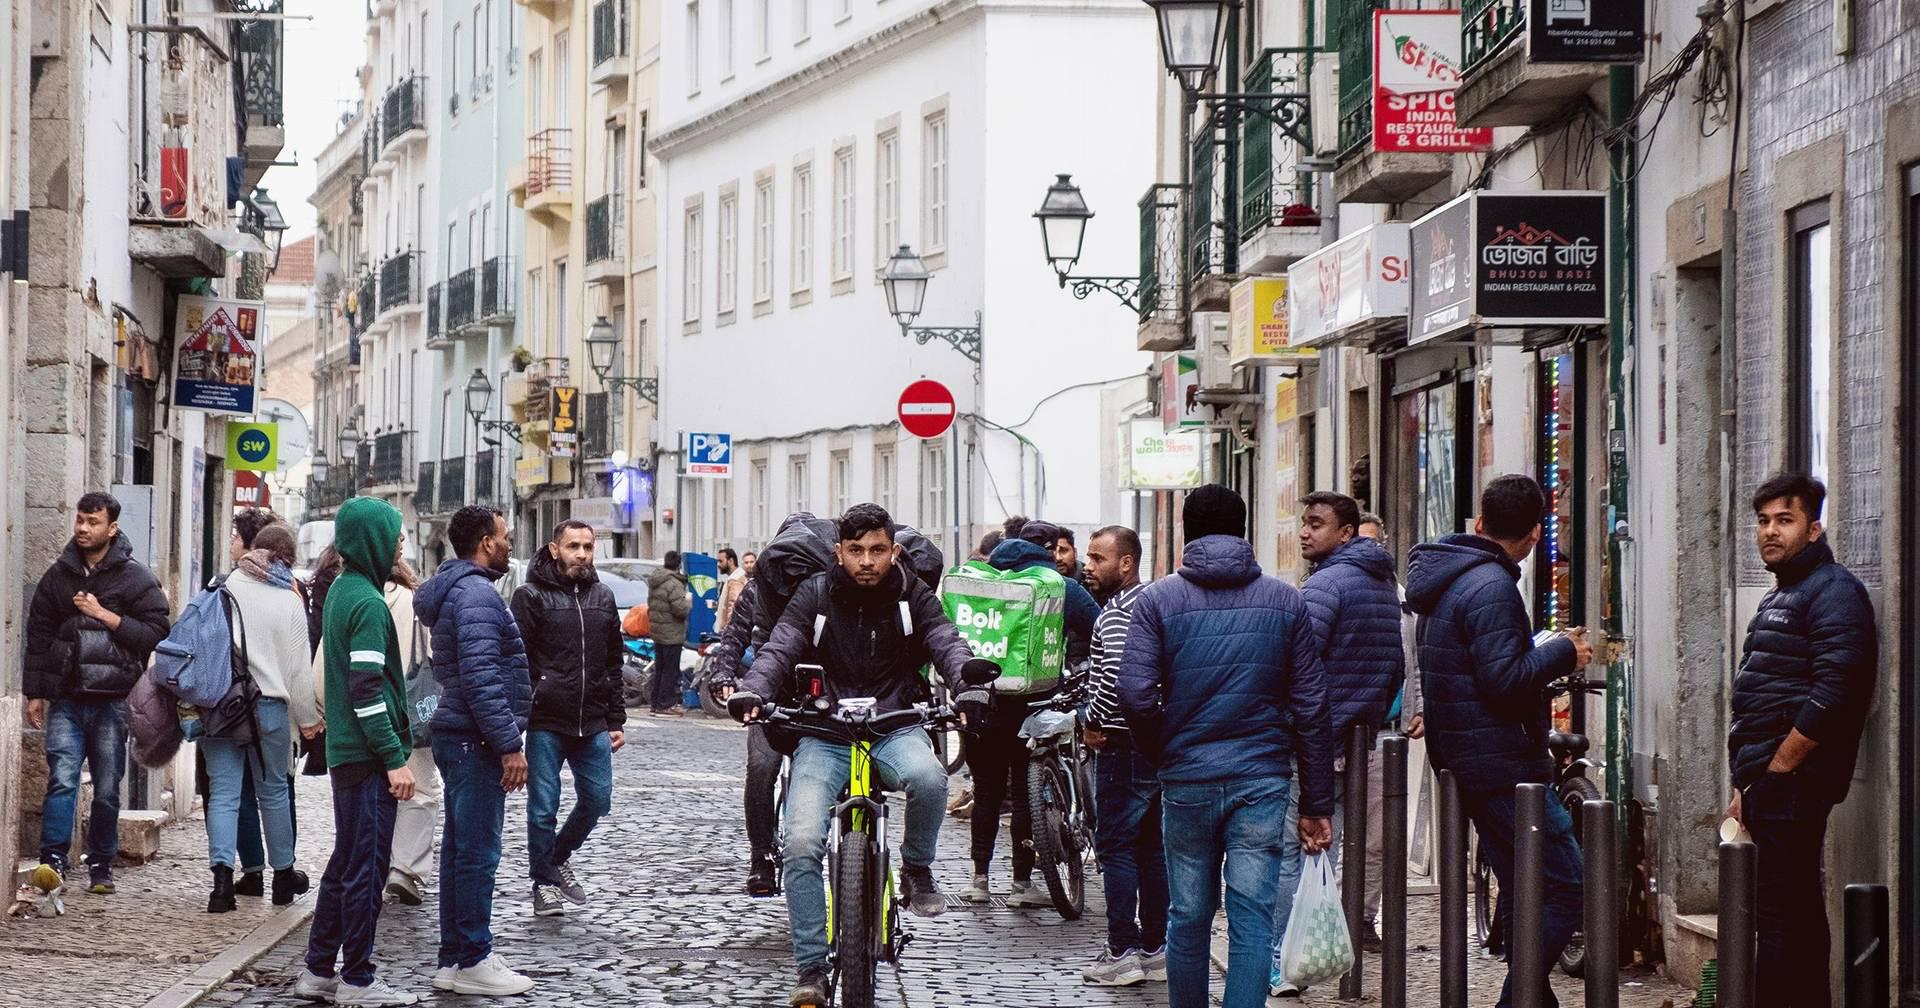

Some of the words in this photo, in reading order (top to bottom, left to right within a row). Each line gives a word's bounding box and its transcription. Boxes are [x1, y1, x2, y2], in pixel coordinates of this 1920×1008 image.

[1388, 92, 1456, 110] SPIC
[1397, 135, 1410, 146] &
[1417, 135, 1471, 146] GRILL
[1484, 283, 1511, 292] INDIAN
[1512, 283, 1565, 292] RESTAURANT
[1566, 283, 1573, 292] &
[1573, 283, 1597, 292] PIZZA
[555, 388, 576, 432] VIP
[693, 435, 708, 458] P
[955, 604, 1002, 630] Bolt
[958, 632, 1008, 658] ood
